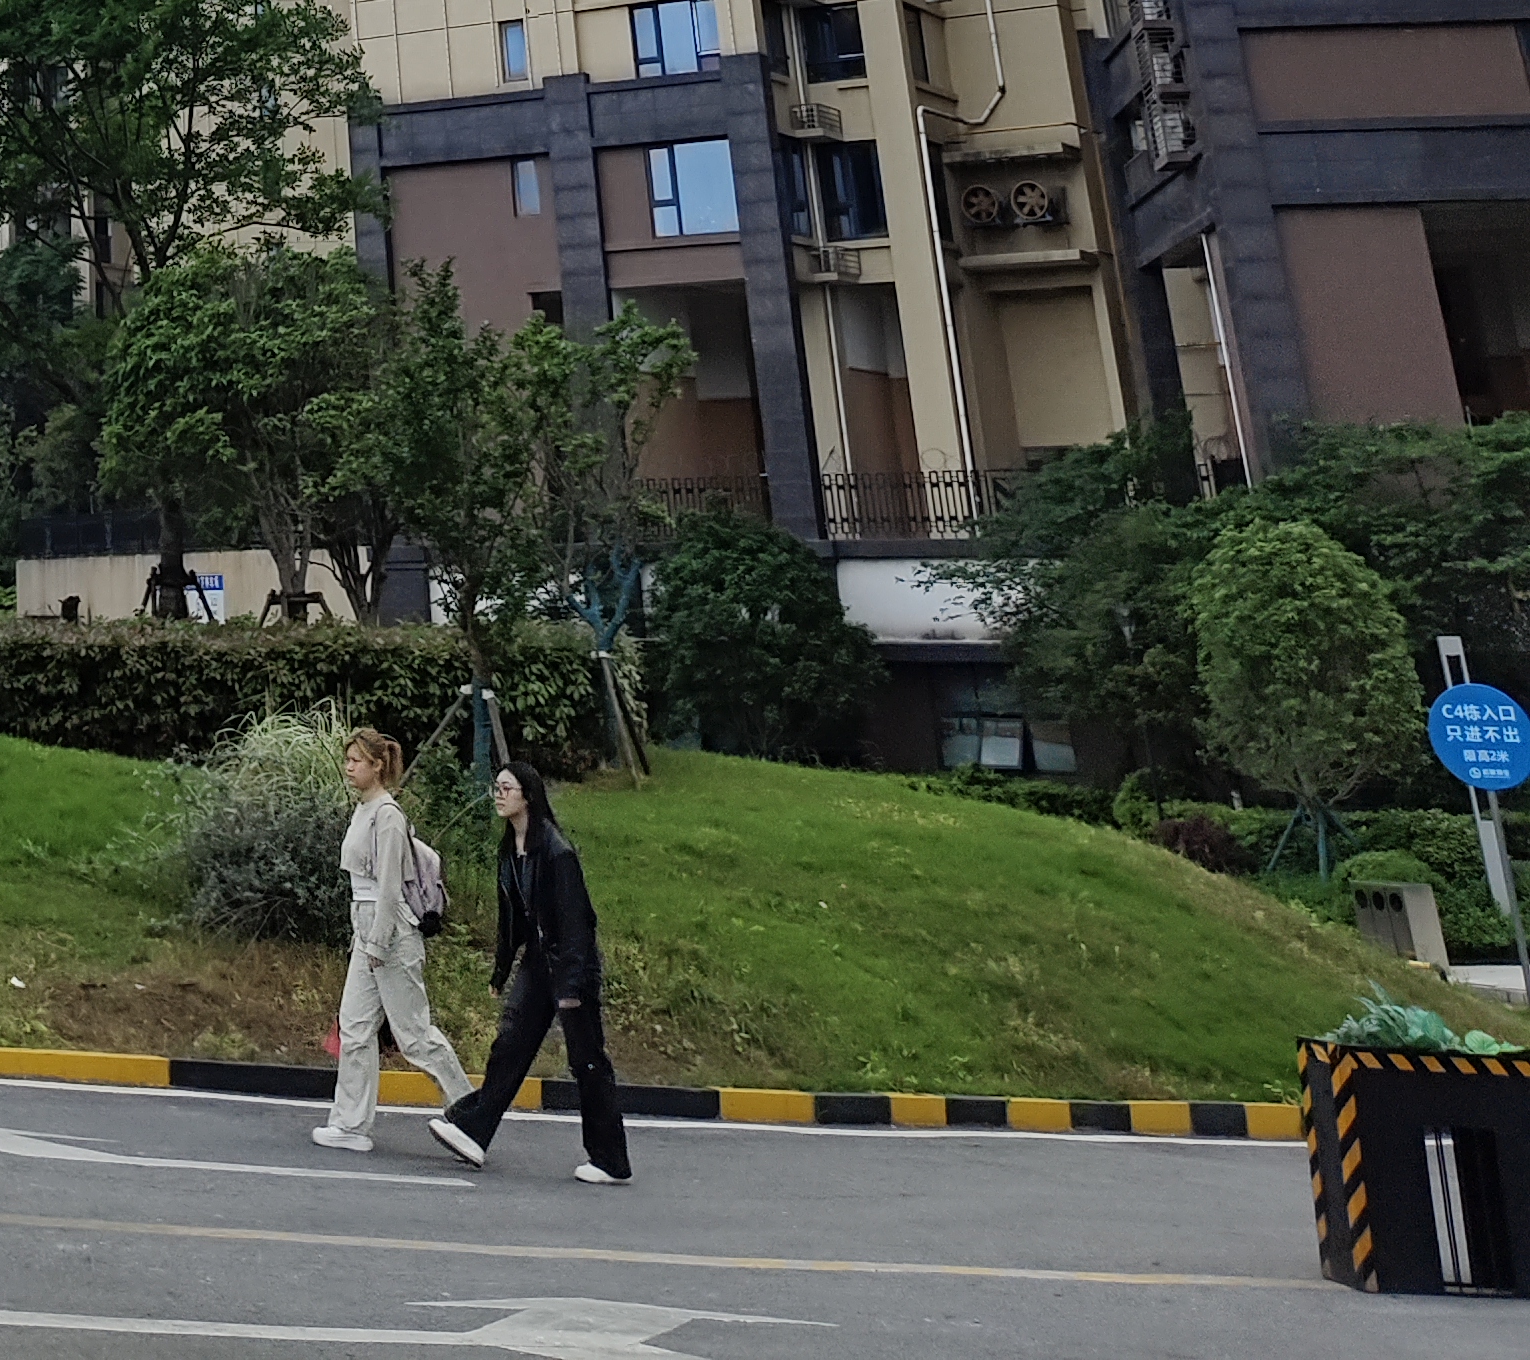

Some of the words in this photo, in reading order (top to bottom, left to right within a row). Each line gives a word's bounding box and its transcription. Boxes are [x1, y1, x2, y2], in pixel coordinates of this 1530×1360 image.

[1441, 703, 1517, 722] C4栋入口
[1446, 725, 1521, 744] 只进不出
